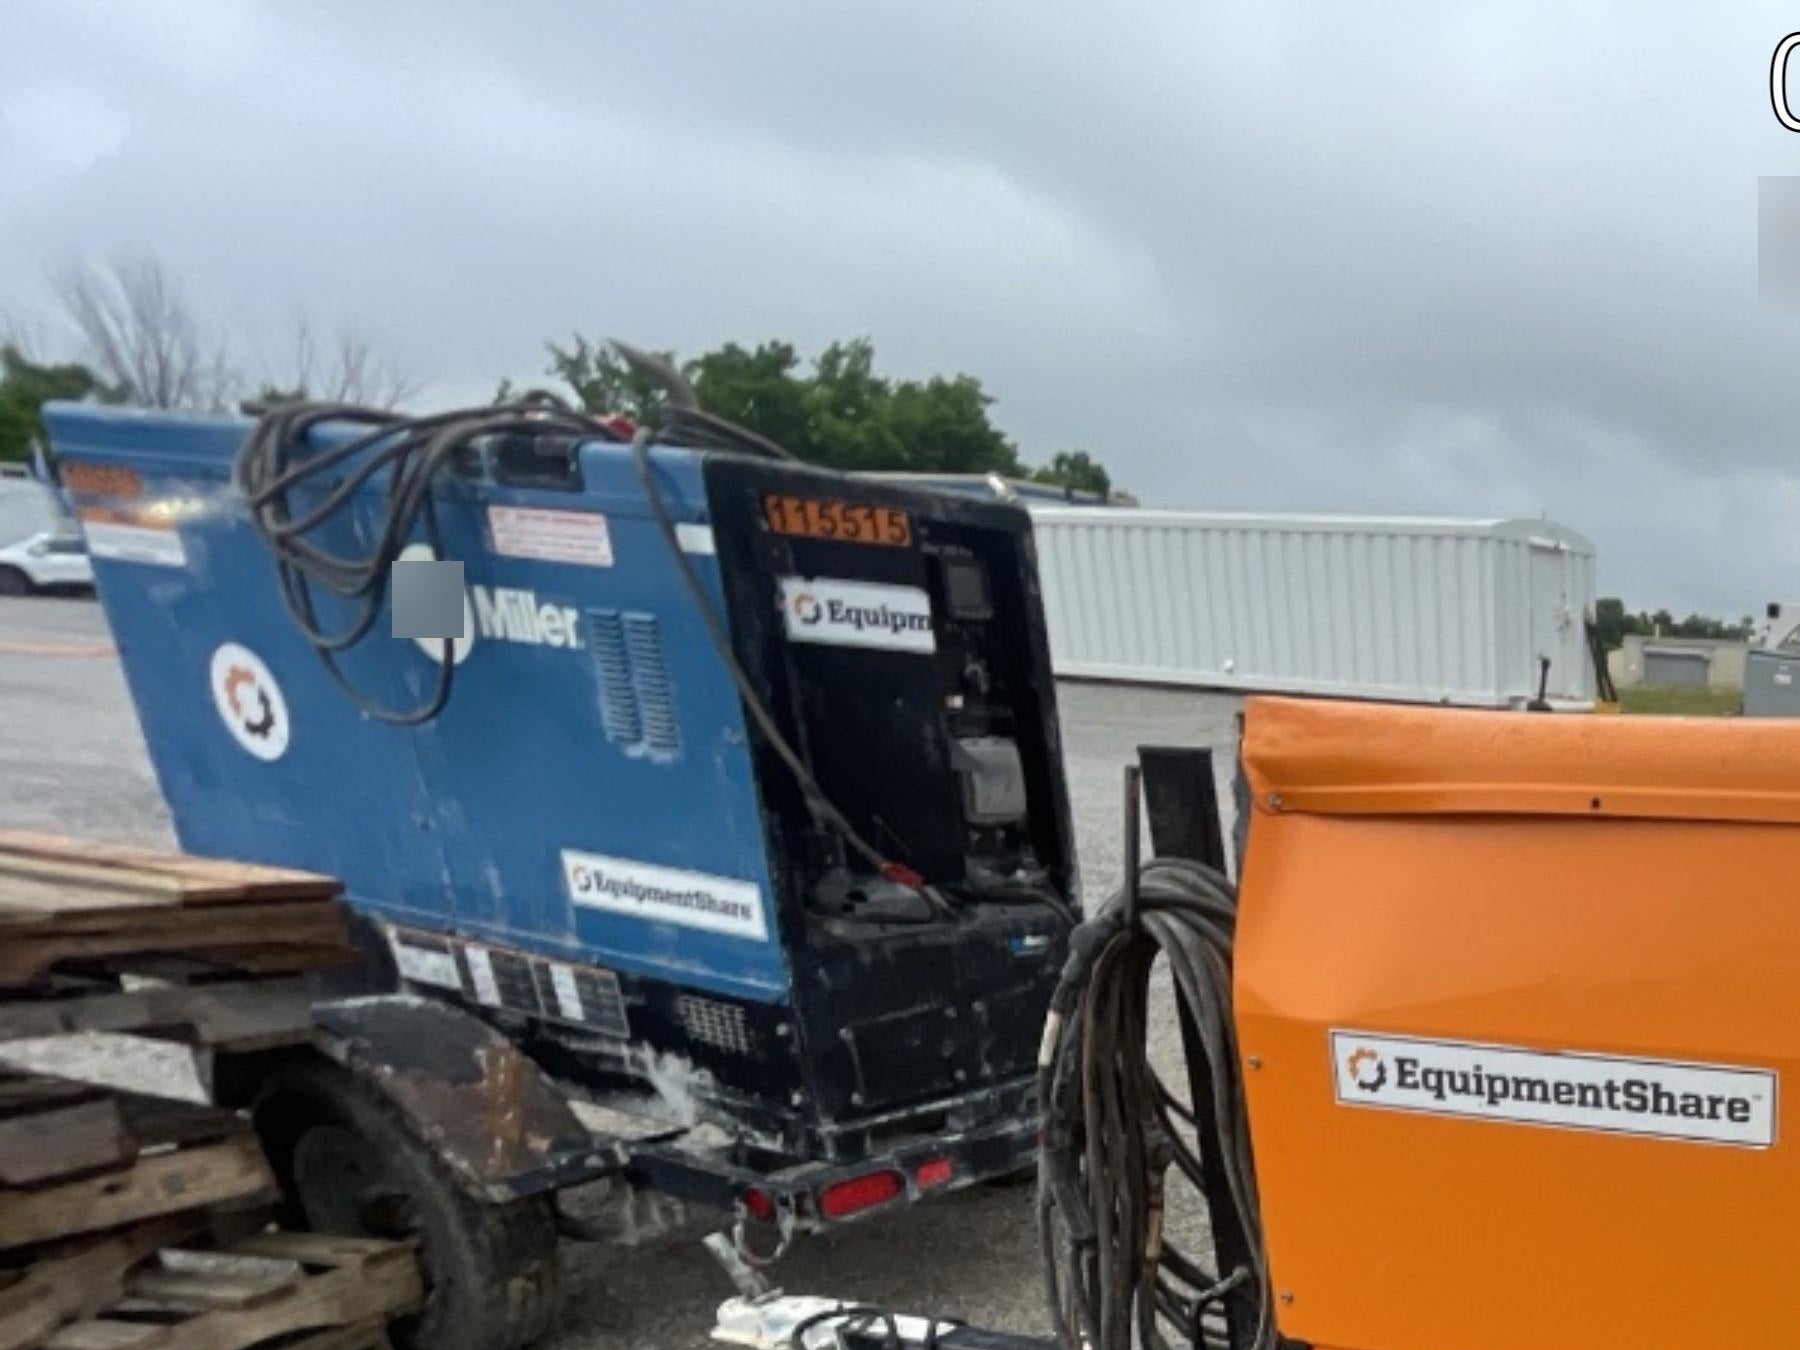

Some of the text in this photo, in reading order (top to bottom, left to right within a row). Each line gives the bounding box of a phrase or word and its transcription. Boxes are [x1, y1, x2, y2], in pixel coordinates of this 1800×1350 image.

[768, 498, 909, 545] 115515
[473, 584, 579, 649] Miller
[1394, 1056, 1751, 1123] EquipmentShare
